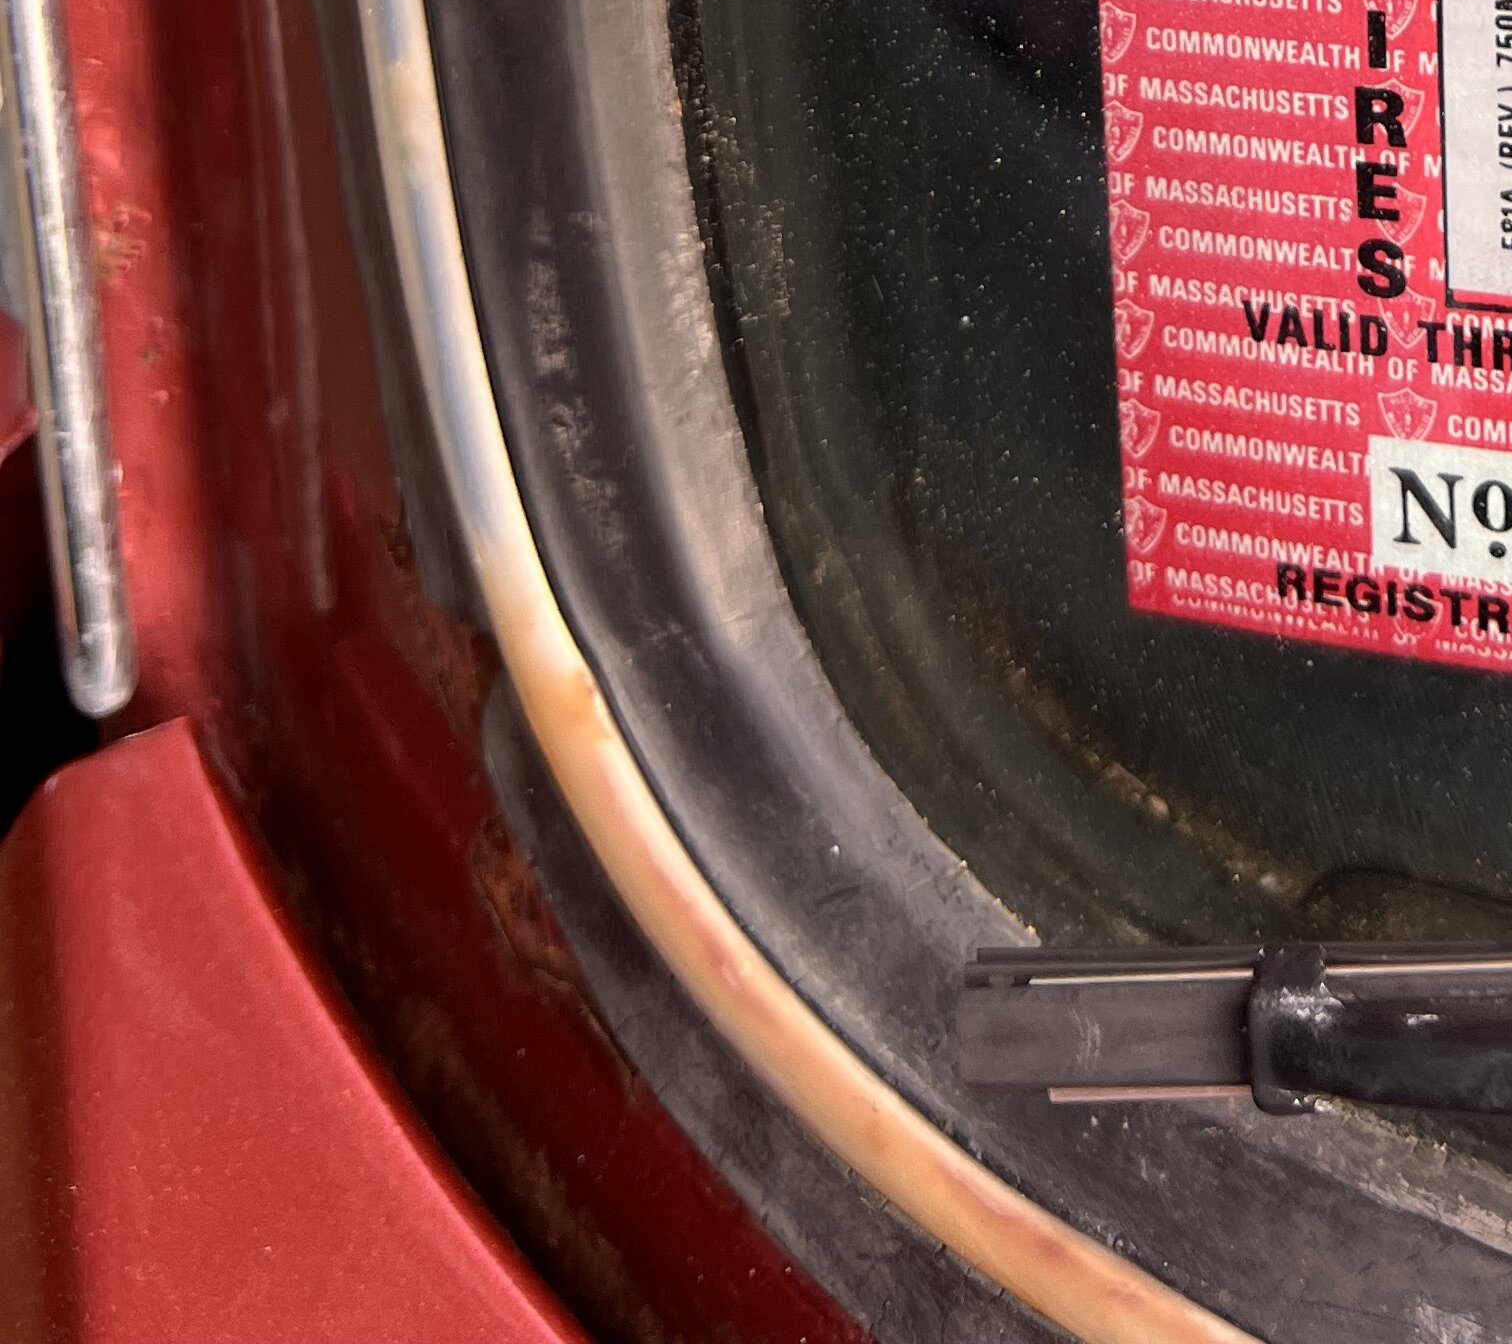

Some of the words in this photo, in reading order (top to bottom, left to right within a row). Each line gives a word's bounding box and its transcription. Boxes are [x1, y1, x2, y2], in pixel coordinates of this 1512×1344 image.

[1146, 26, 1360, 70] COMMONWEALTH
[1140, 77, 1348, 120] MASSACHUSETTS
[1153, 126, 1365, 170] COMMONWEALTH
[1147, 176, 1353, 221] MASSACHUSETTS
[1242, 299, 1389, 358] VALID
[1388, 357, 1418, 382] OF
[1155, 374, 1360, 426] MASSACHUSETTS
[1159, 472, 1364, 525] MASSACHUSETTS
